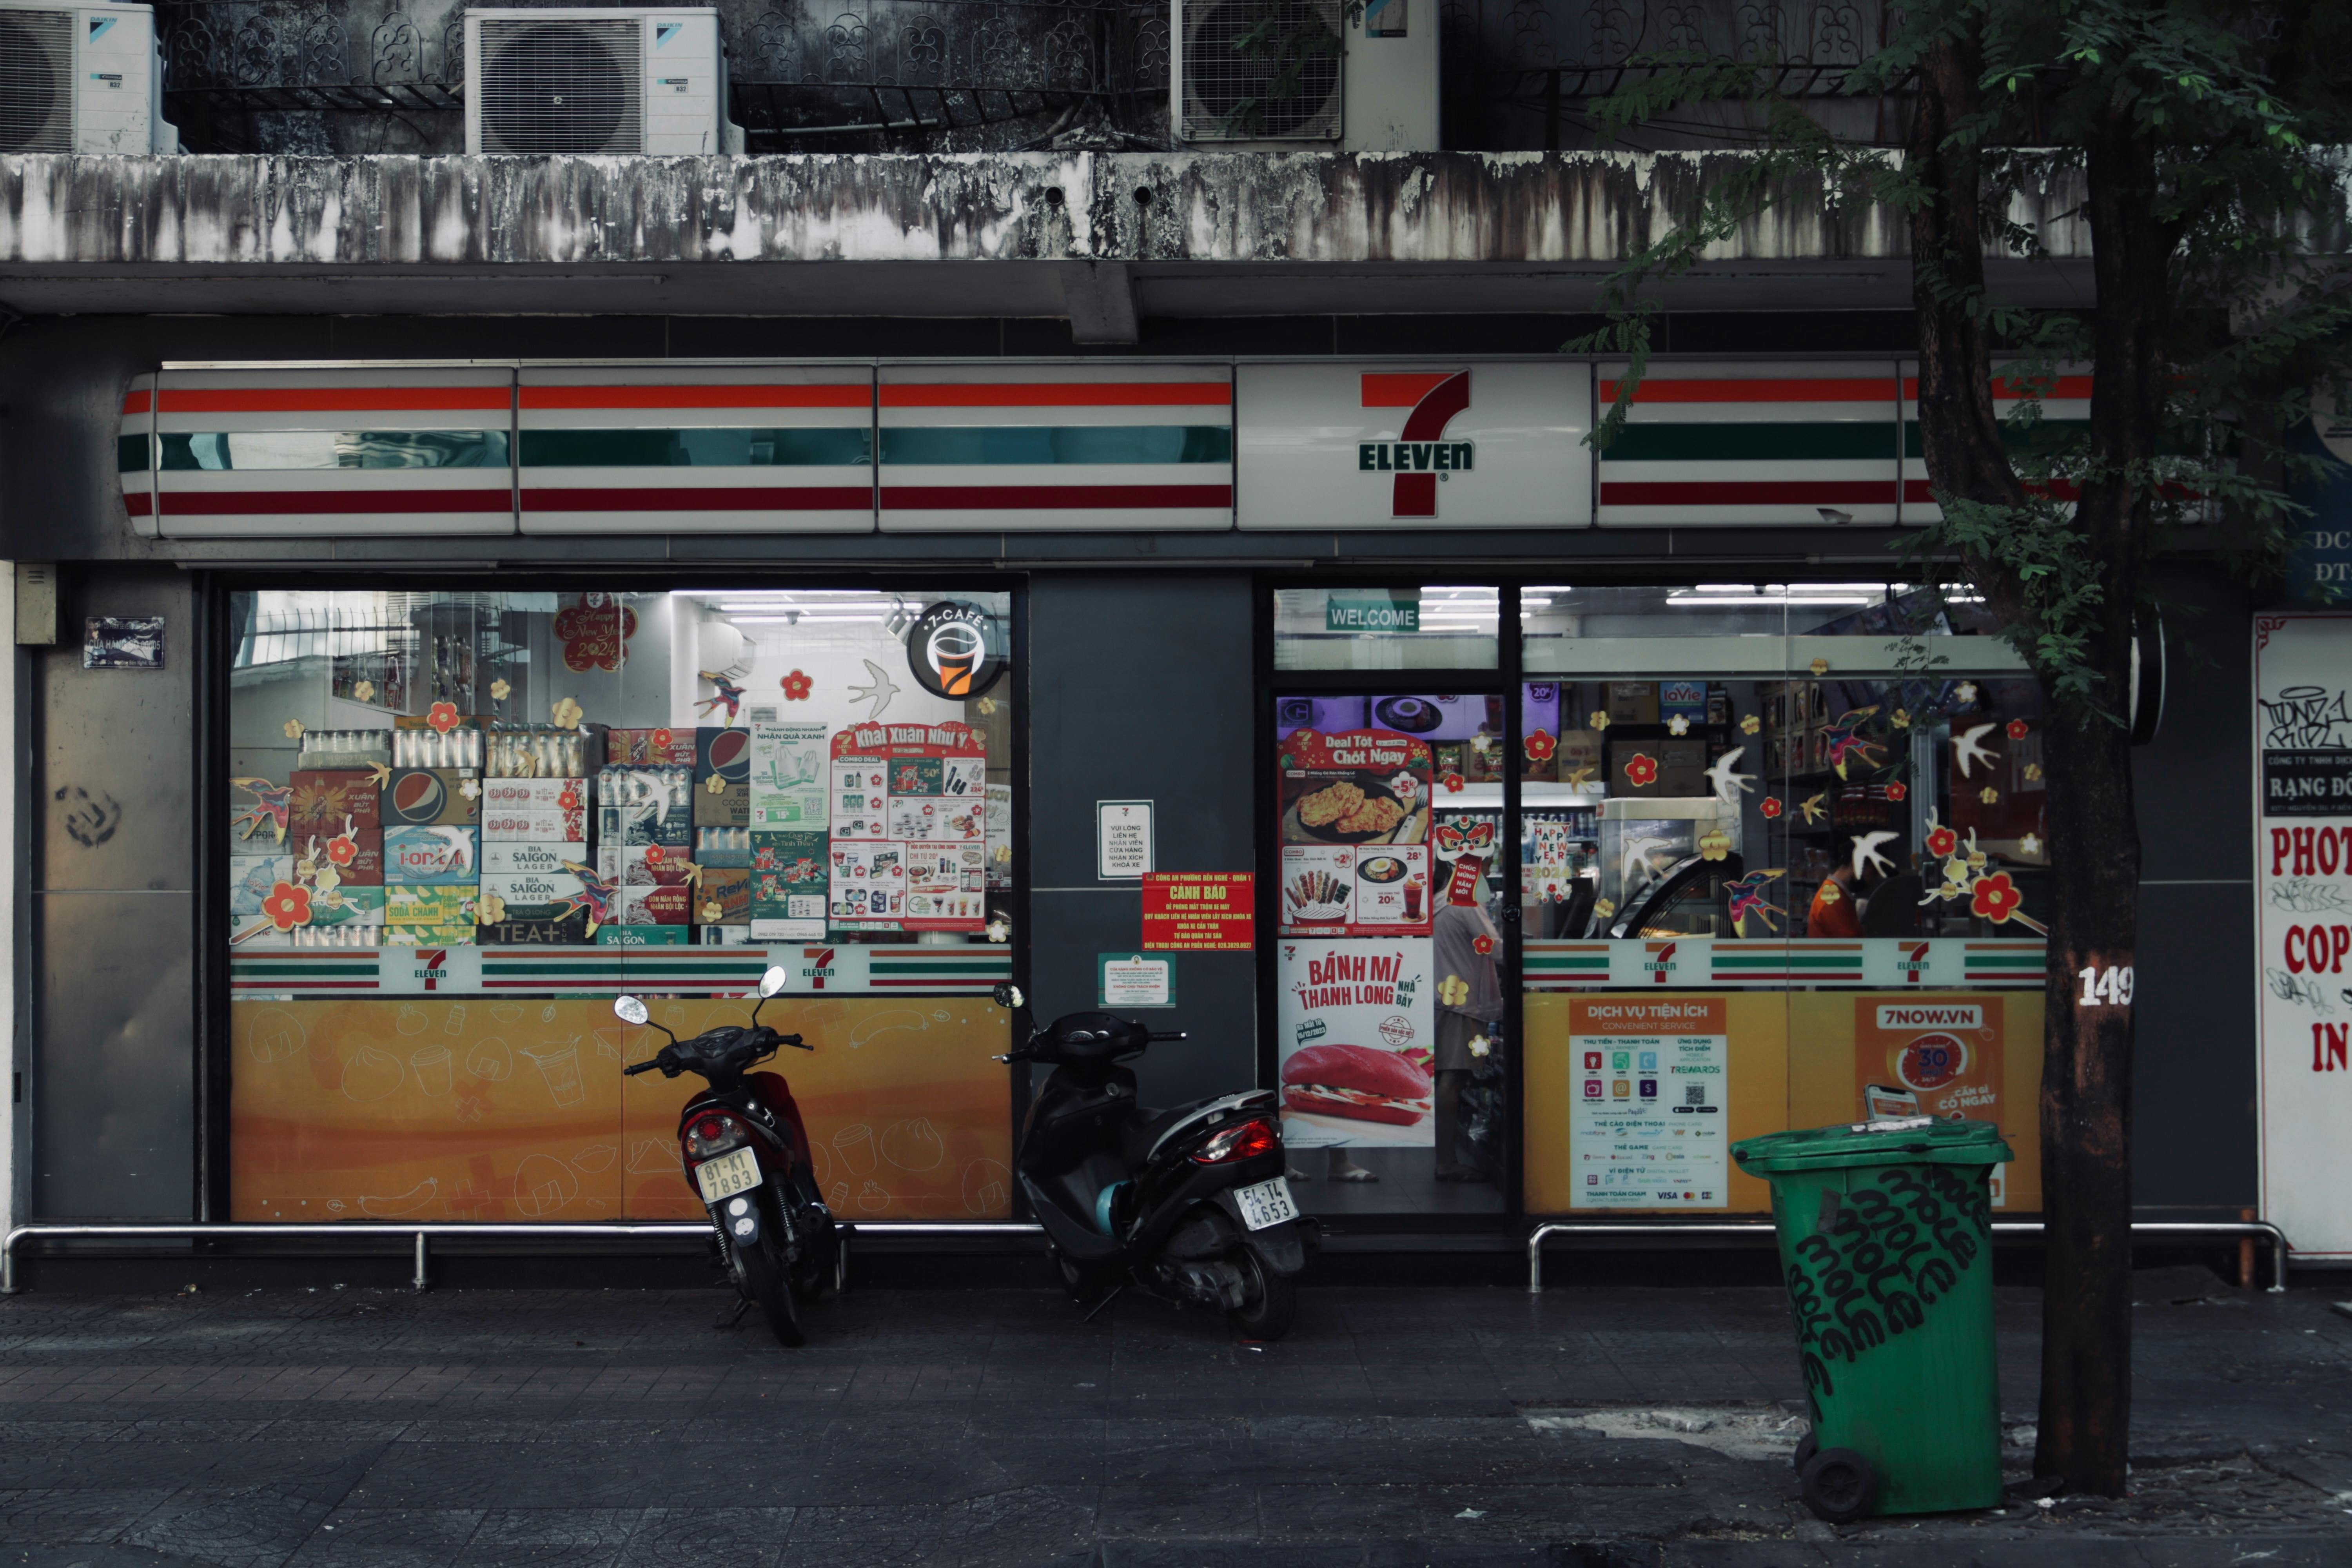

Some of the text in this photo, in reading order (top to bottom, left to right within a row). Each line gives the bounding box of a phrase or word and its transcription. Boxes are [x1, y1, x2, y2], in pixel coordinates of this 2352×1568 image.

[576, 610, 615, 624] Happy
[1332, 609, 1415, 626] WELCOME
[564, 626, 597, 639] New
[757, 732, 781, 741] NHẬN
[855, 727, 955, 748] Khai Xuân Như
[1326, 735, 1373, 748] Deal Tốt
[1333, 748, 1406, 765] Chốt Ngay
[348, 792, 375, 800] XUÂN
[2269, 777, 2327, 802] RẠNG
[513, 852, 557, 862] SAIGON
[1458, 863, 1477, 872] CHÚC
[1156, 873, 1170, 882] CÔNG
[1180, 873, 1201, 882] PHƯỜNG
[1202, 873, 1213, 881] BẾN
[1232, 873, 1247, 882] QUẬN
[1456, 871, 1476, 880] MỪNG
[510, 884, 555, 893] SAIGON
[1169, 882, 1227, 900] CẢNH BÁO
[1456, 880, 1472, 889] NĂM
[673, 894, 686, 902] RỒNG
[389, 907, 438, 916] SODA CHANH
[1156, 941, 1169, 949] THOẠI
[1308, 950, 1404, 986] BÁNH MÌ
[1397, 980, 1416, 993] NHÀ
[2078, 965, 2134, 1006] 149
[1298, 984, 1394, 1010] THANH LONG
[1396, 993, 1414, 1008] BẢY
[1588, 1003, 1708, 1020] DỊCH VỤ TIỆN ÍCH
[1885, 1010, 1974, 1024] 7NOW.VN
[1602, 1022, 1695, 1030] CONVENIENT SERVICE
[1297, 1027, 1326, 1040] 15/12/2023
[2311, 1022, 2349, 1072] IN
[1918, 1048, 1949, 1067] 30
[1670, 1065, 1720, 1074] 7REWARDS
[1955, 1085, 1976, 1097] CẦN
[1939, 1093, 1996, 1109] CÓ NGAY
[709, 1170, 752, 1198] 7893
[1252, 1200, 1290, 1226] 4653
